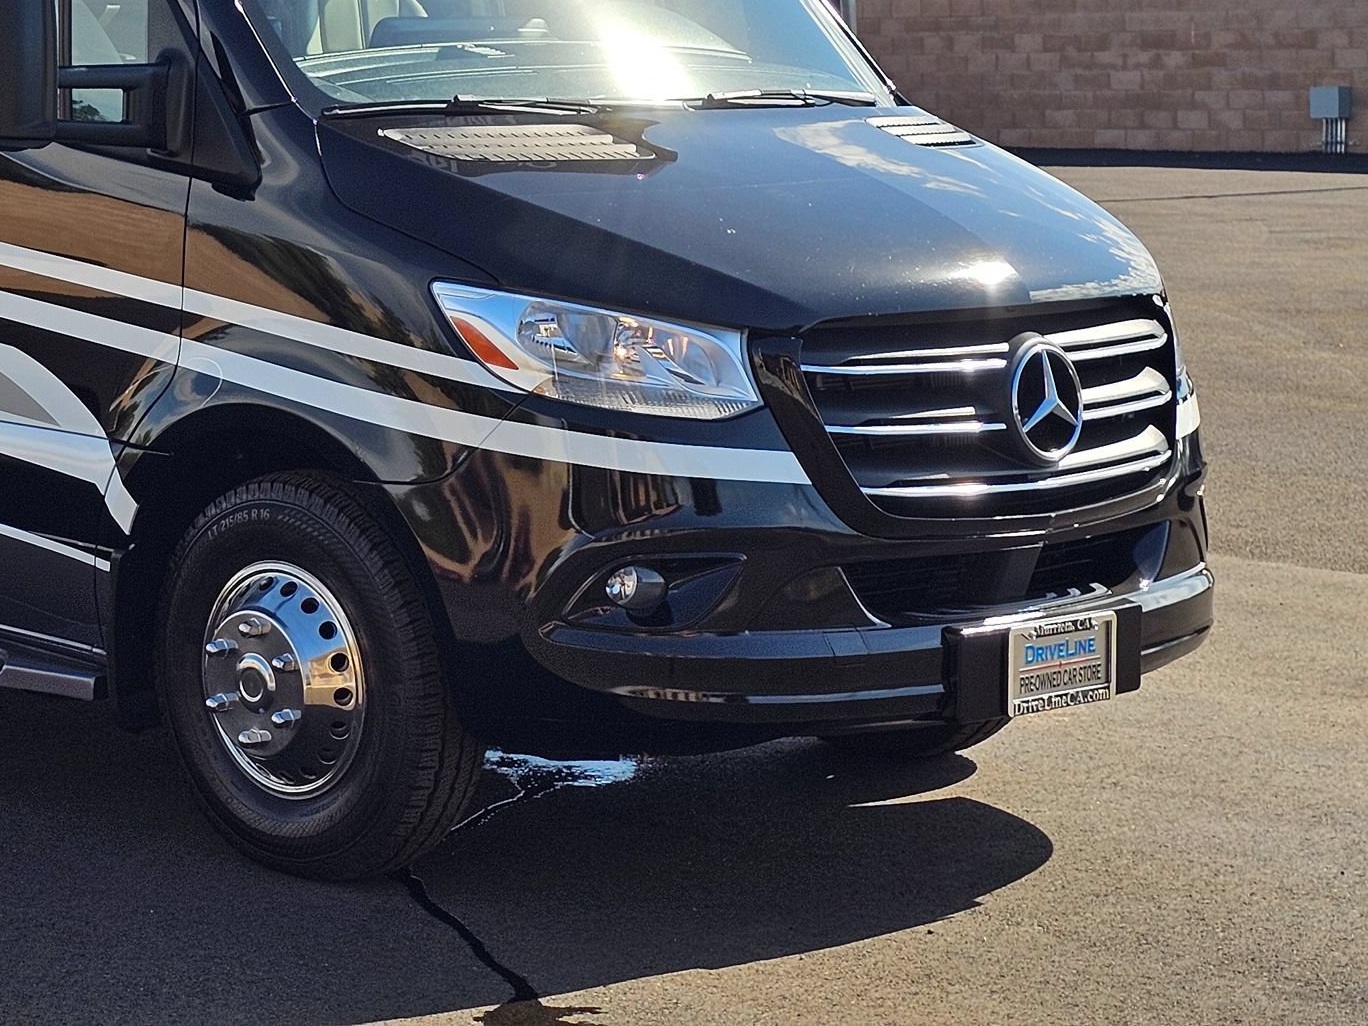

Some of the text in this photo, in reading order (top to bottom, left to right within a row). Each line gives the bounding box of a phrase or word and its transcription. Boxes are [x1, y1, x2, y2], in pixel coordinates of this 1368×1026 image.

[220, 509, 249, 532] 215/85
[1062, 666, 1078, 686] CAR
[1078, 663, 1102, 683] STORE
[1014, 688, 1110, 715] DriveLineCA.com
